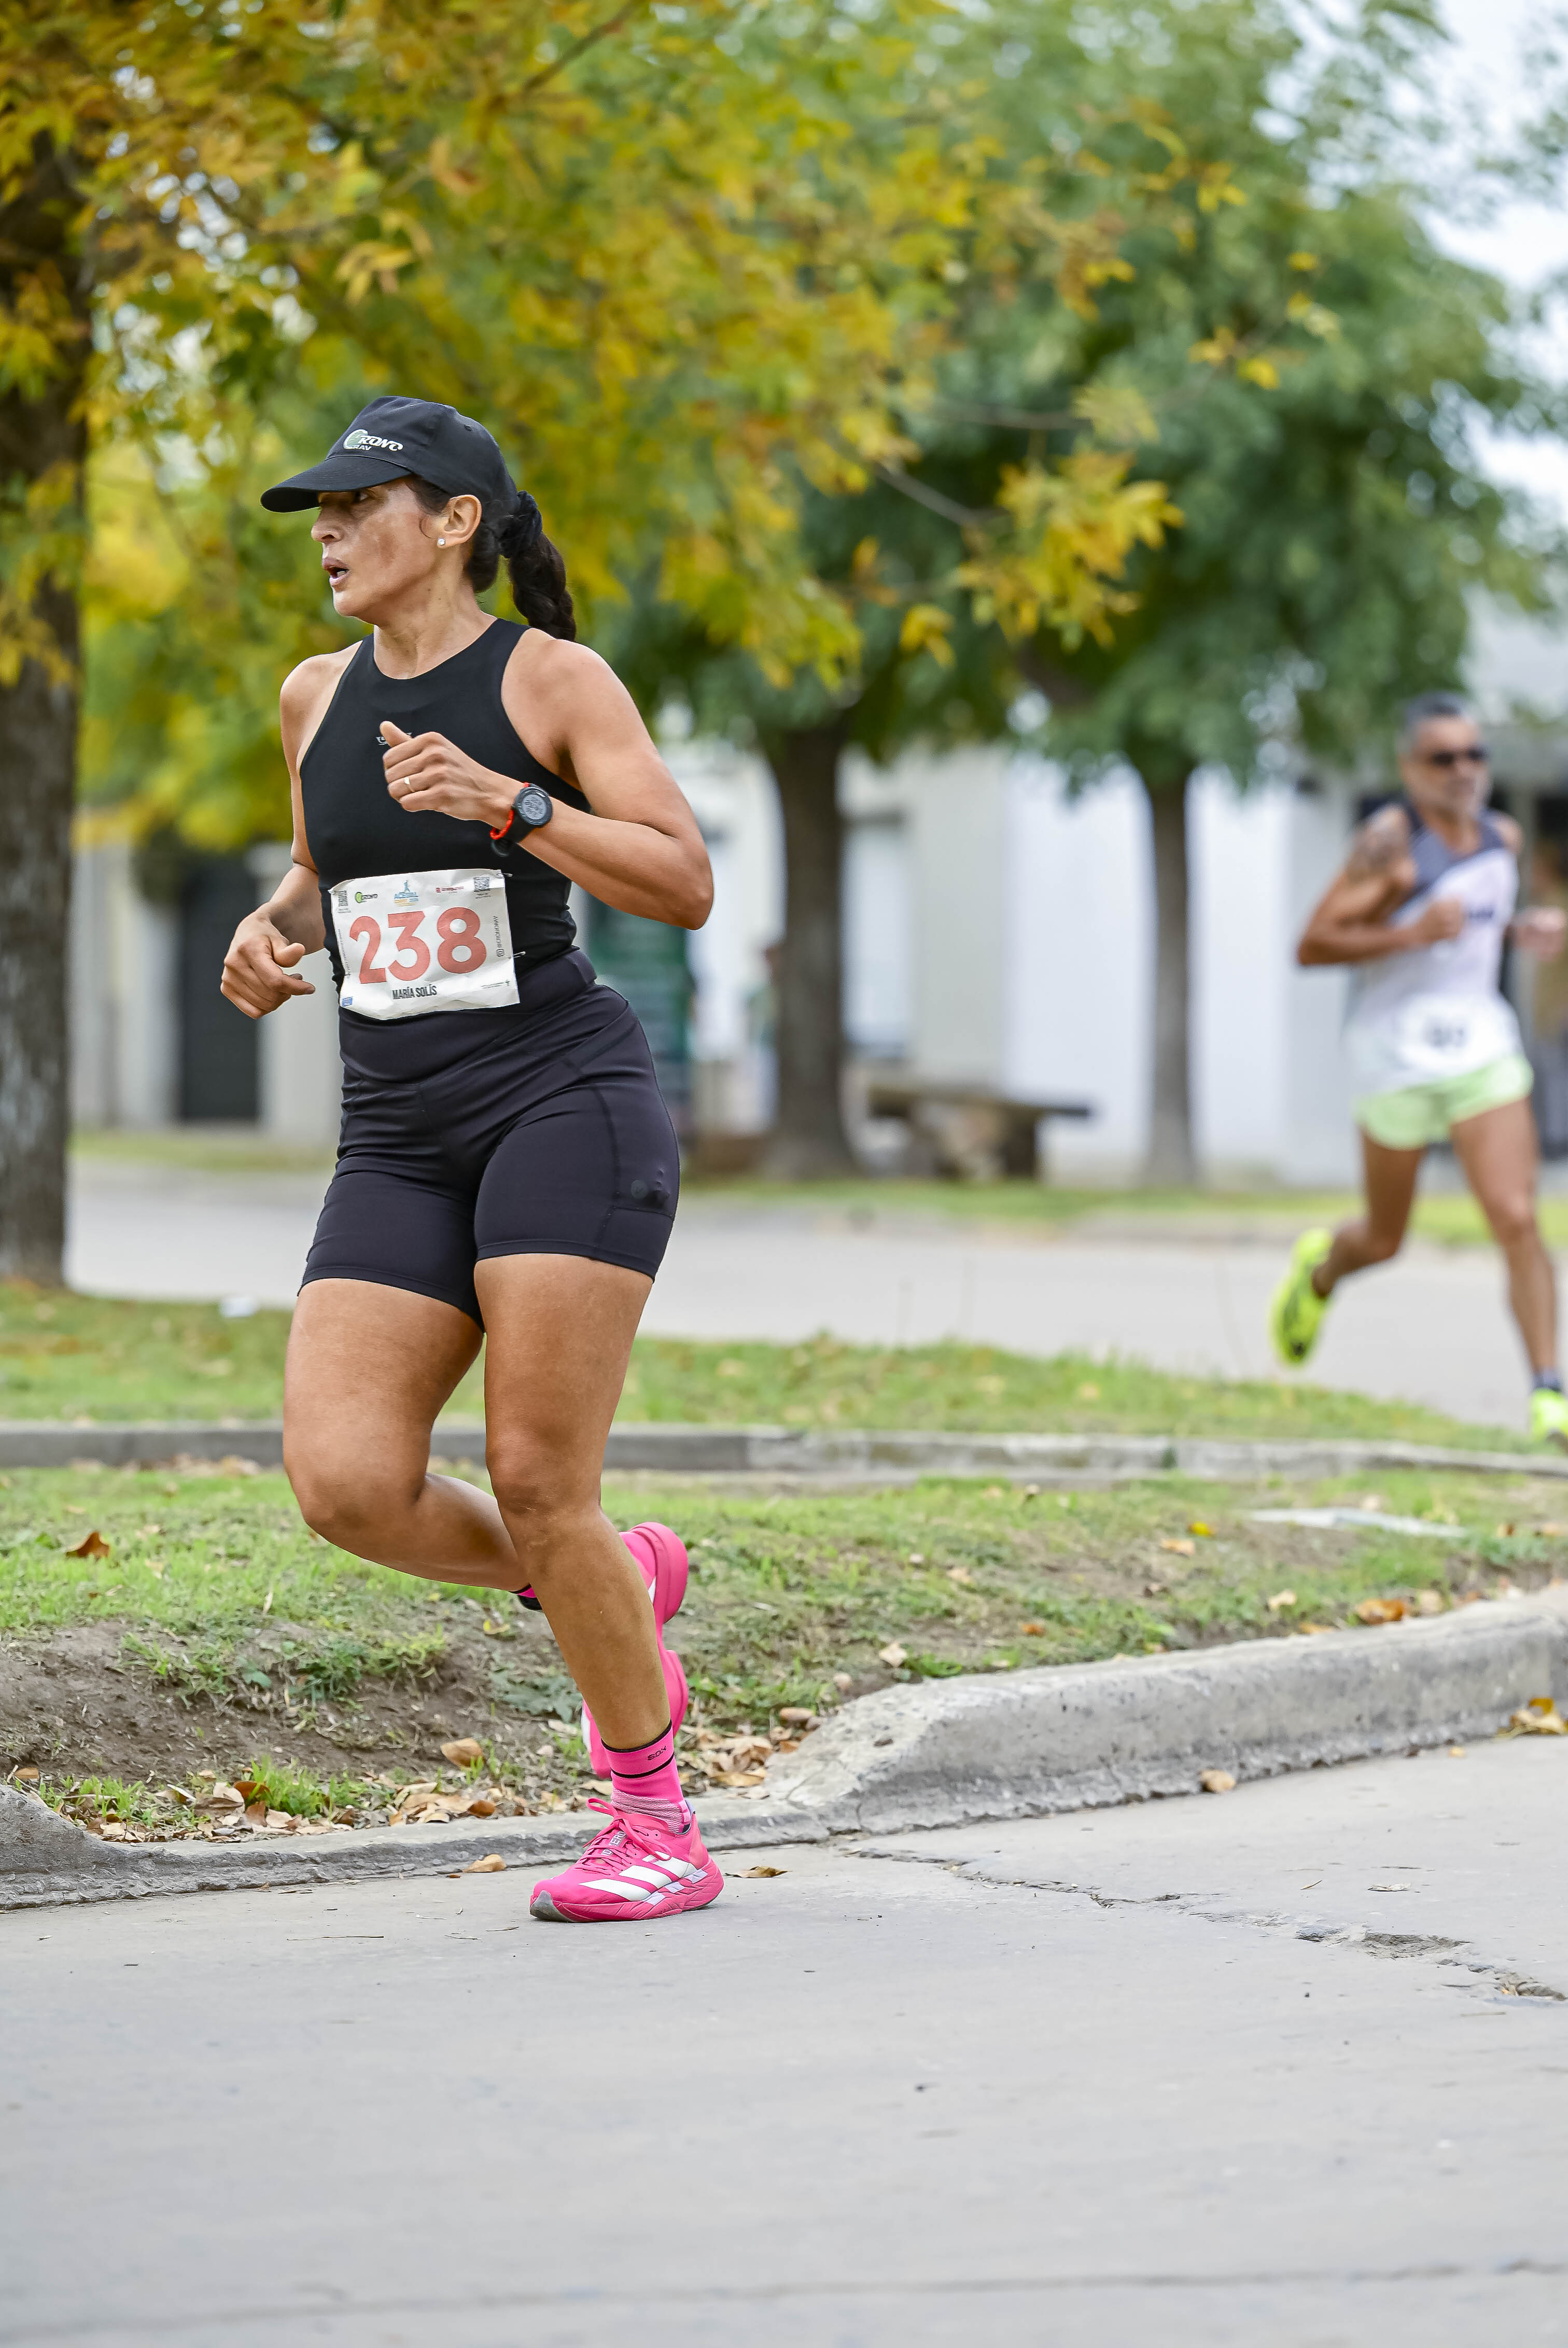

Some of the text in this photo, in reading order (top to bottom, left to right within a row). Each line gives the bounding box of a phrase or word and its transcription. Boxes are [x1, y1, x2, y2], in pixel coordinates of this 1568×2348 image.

[349, 907, 487, 984] 238
[392, 984, 437, 1000] MARÍA SOLÍS
